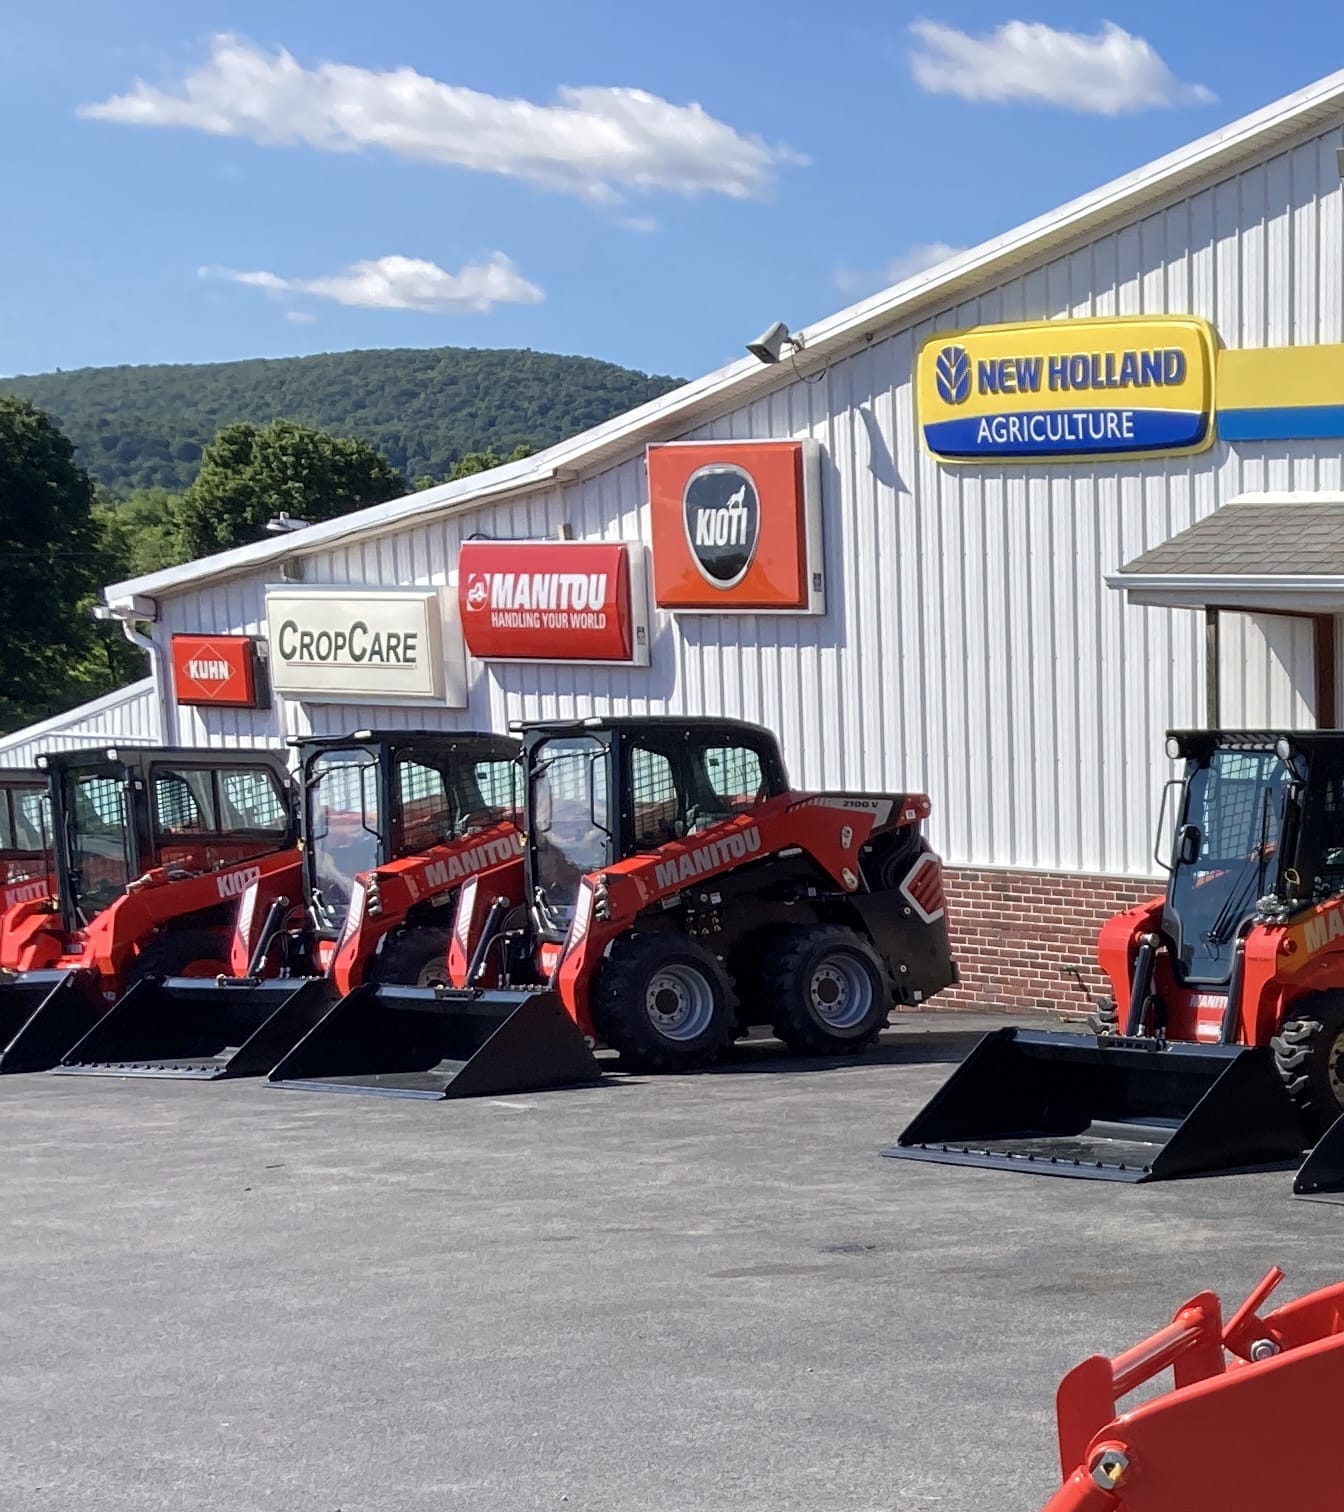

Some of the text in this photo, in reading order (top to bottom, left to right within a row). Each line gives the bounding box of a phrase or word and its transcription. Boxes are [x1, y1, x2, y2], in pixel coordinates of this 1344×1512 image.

[977, 346, 1188, 395] NEW HOLLAND
[976, 411, 1135, 444] AGRICULTURE
[695, 507, 748, 547] KIOTI
[491, 573, 607, 610] MANITOU
[491, 612, 606, 630] HANDLING YOUR WORLD
[188, 659, 230, 681] KUHN
[654, 826, 761, 889] MANITOU
